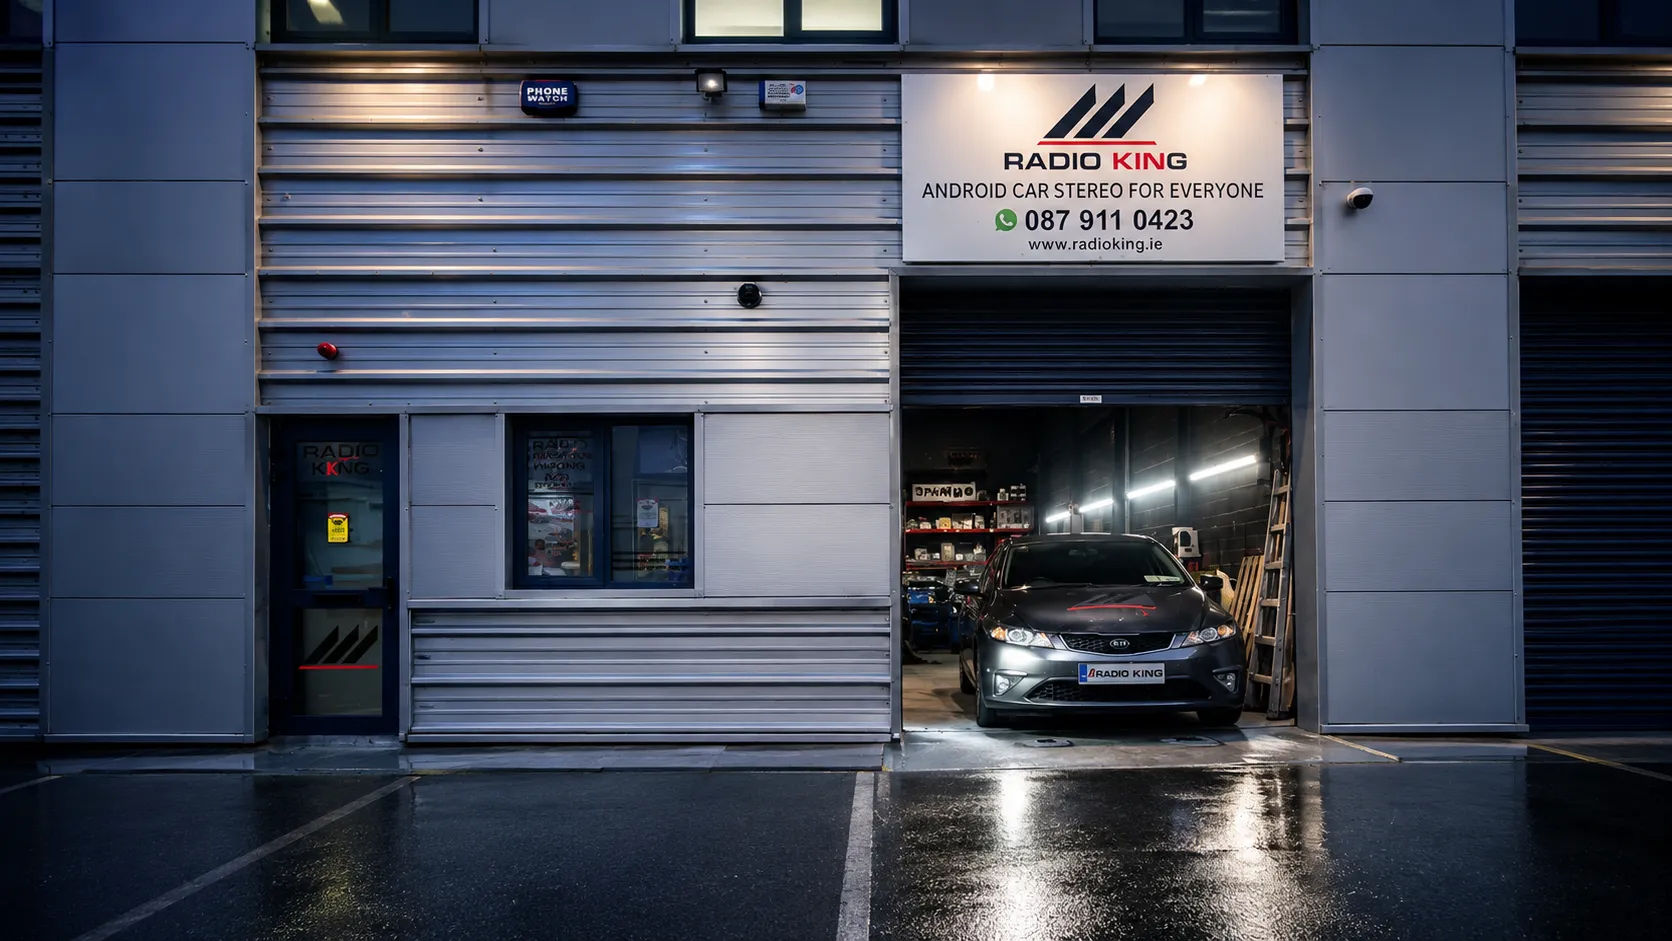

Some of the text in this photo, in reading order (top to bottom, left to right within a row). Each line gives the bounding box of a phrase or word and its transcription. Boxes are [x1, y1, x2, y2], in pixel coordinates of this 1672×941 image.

[527, 87, 568, 95] PHONE
[1004, 152, 1187, 170] RADIO KING
[922, 182, 1264, 199] ANDROID CAR STEREO FOR EVERYONE
[1025, 209, 1194, 231] 087 911 0423
[1028, 238, 1163, 253] www.radioking.ie
[303, 444, 379, 459] RADIO
[1132, 669, 1163, 678] KING
